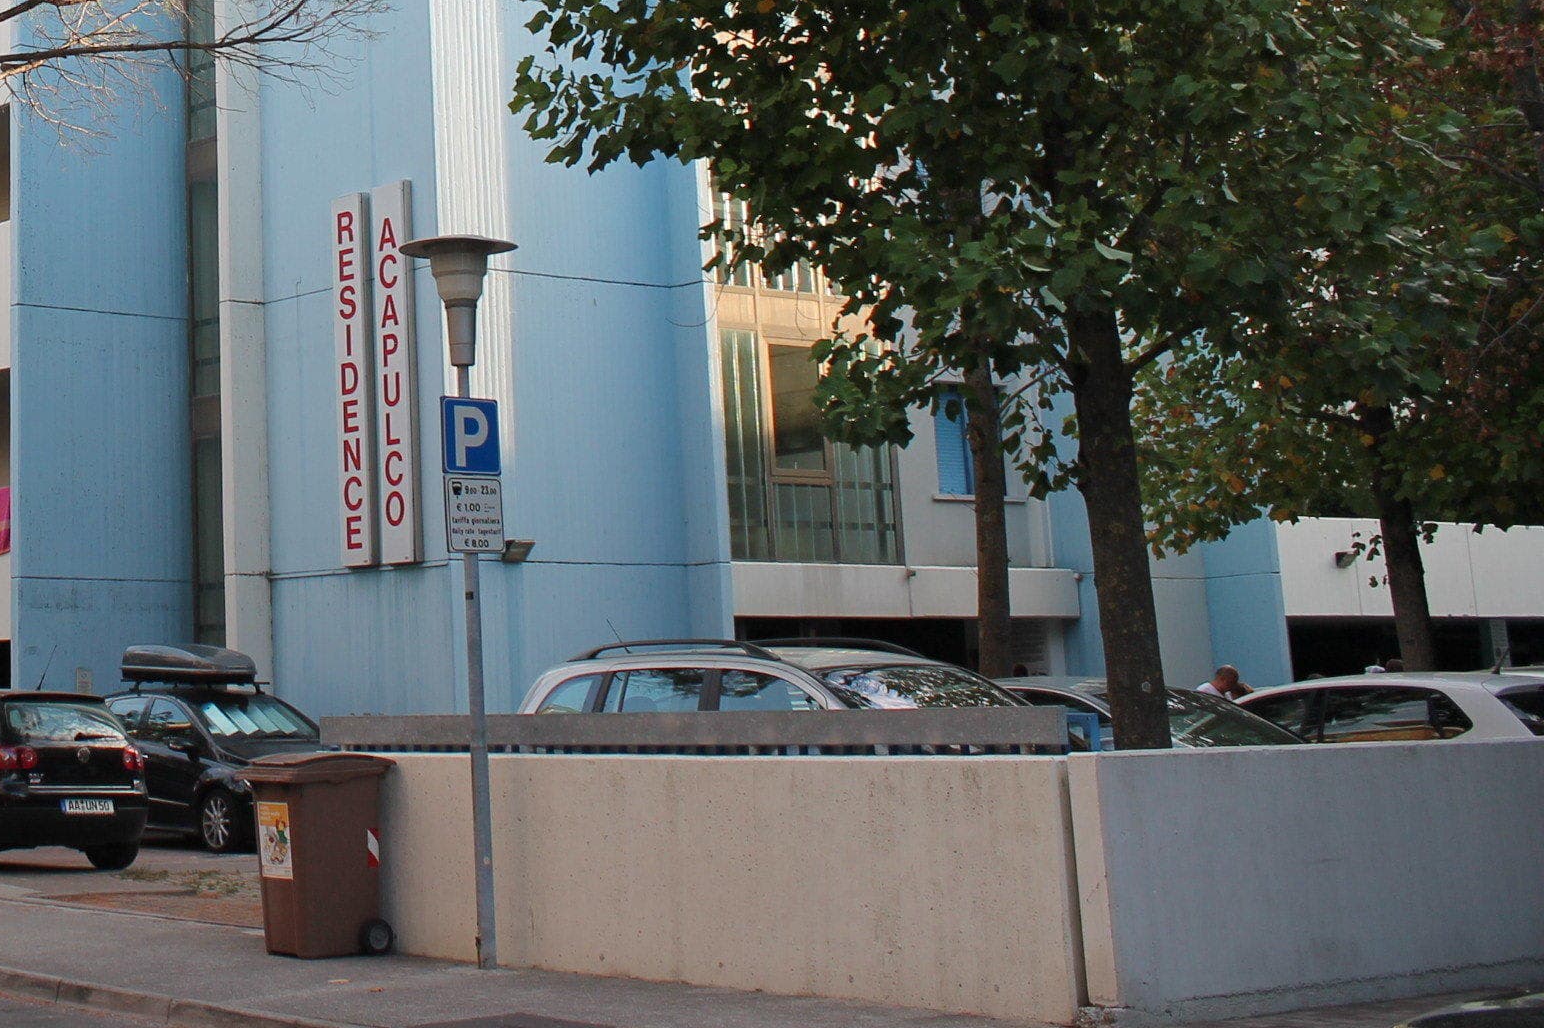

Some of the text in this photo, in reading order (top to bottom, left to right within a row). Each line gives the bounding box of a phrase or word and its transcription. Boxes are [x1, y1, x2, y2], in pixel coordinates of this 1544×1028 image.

[336, 210, 364, 550] RESIDENCE
[378, 217, 405, 527] ACAPULCO
[453, 404, 489, 468] P
[452, 516, 500, 525] tariffa giornaliera
